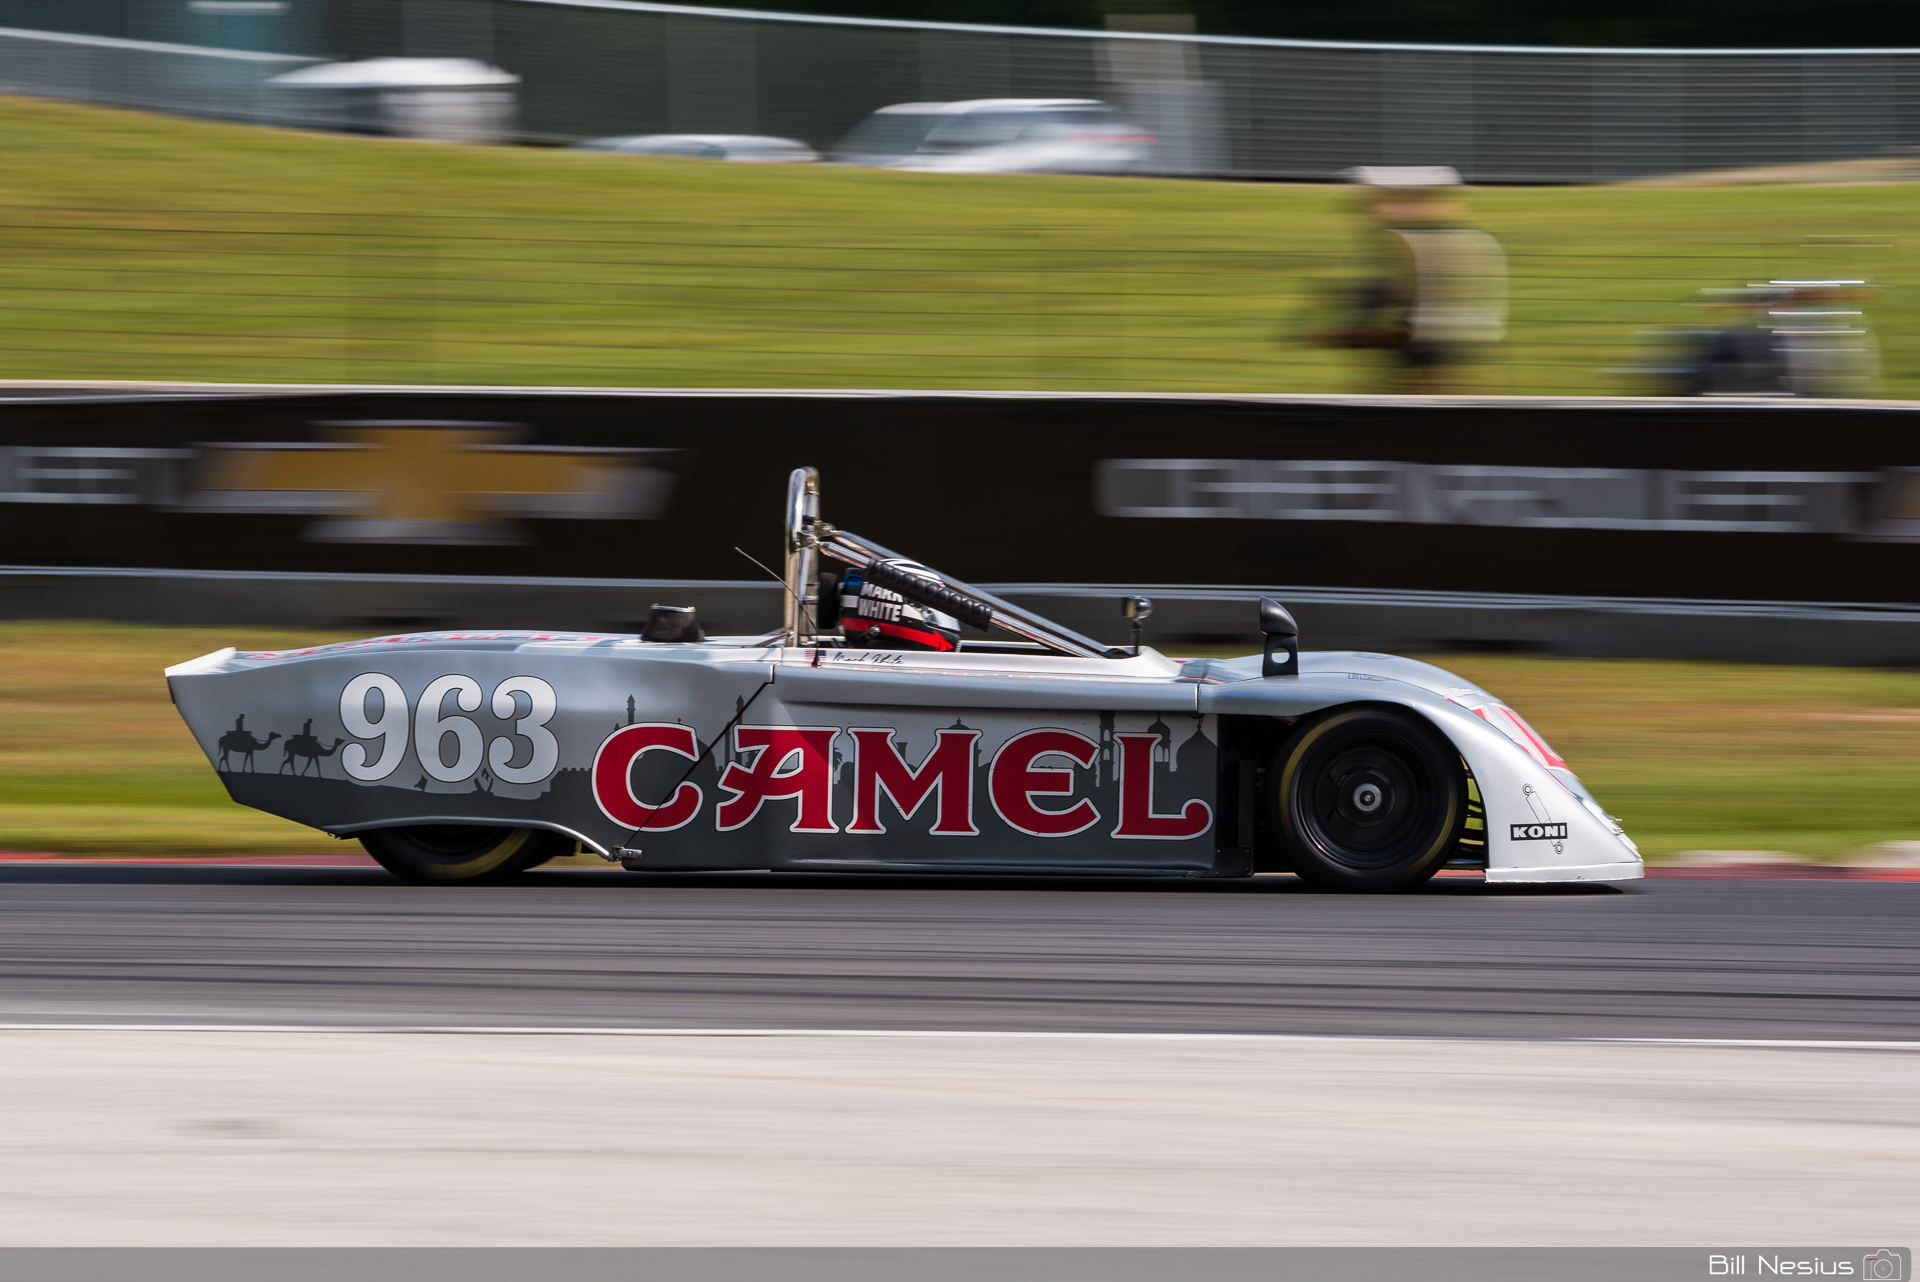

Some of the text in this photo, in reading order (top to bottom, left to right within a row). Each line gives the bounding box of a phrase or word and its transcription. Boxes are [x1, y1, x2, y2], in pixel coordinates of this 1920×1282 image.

[857, 598, 903, 622] WHITE
[339, 672, 560, 785] 963
[591, 721, 1214, 841] CAMEL
[1513, 825, 1566, 838] KONI
